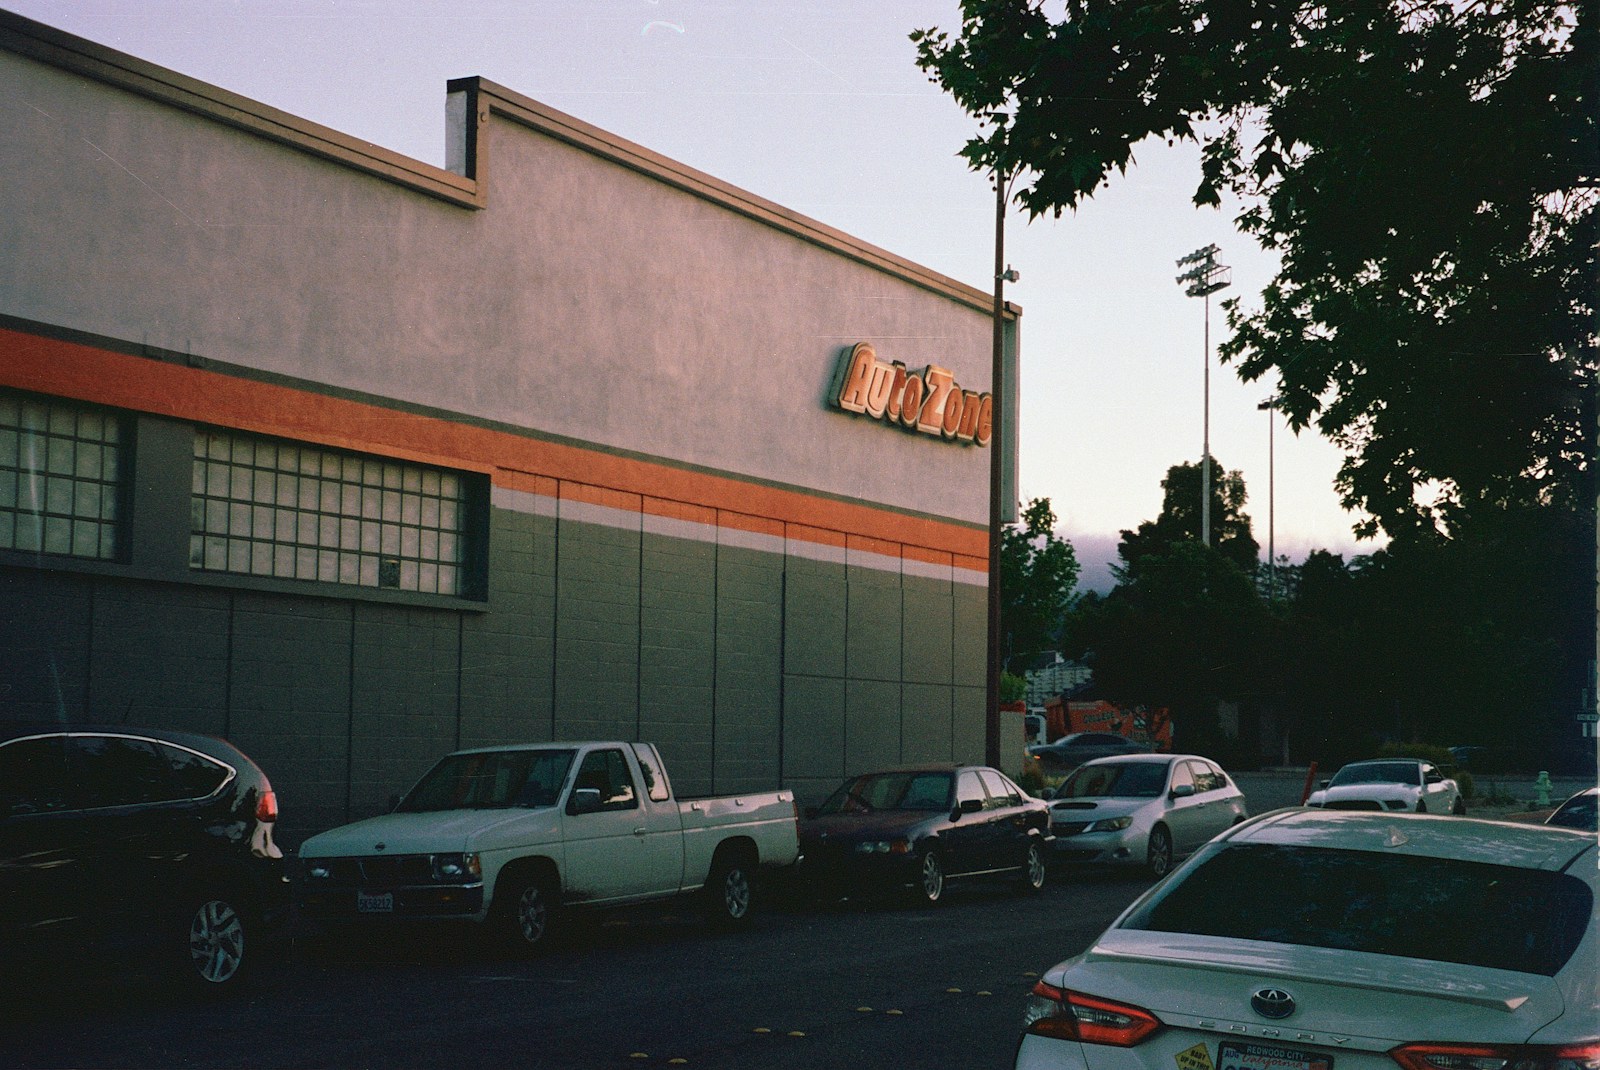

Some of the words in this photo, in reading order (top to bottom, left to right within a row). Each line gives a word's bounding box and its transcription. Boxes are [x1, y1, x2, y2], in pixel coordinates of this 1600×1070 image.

[839, 342, 992, 447] AutoZone
[1199, 1020, 1351, 1044] CAMRY
[1242, 1053, 1303, 1069] California
[1246, 1045, 1286, 1058] REDWOOD
[1286, 1051, 1304, 1061] CITY
